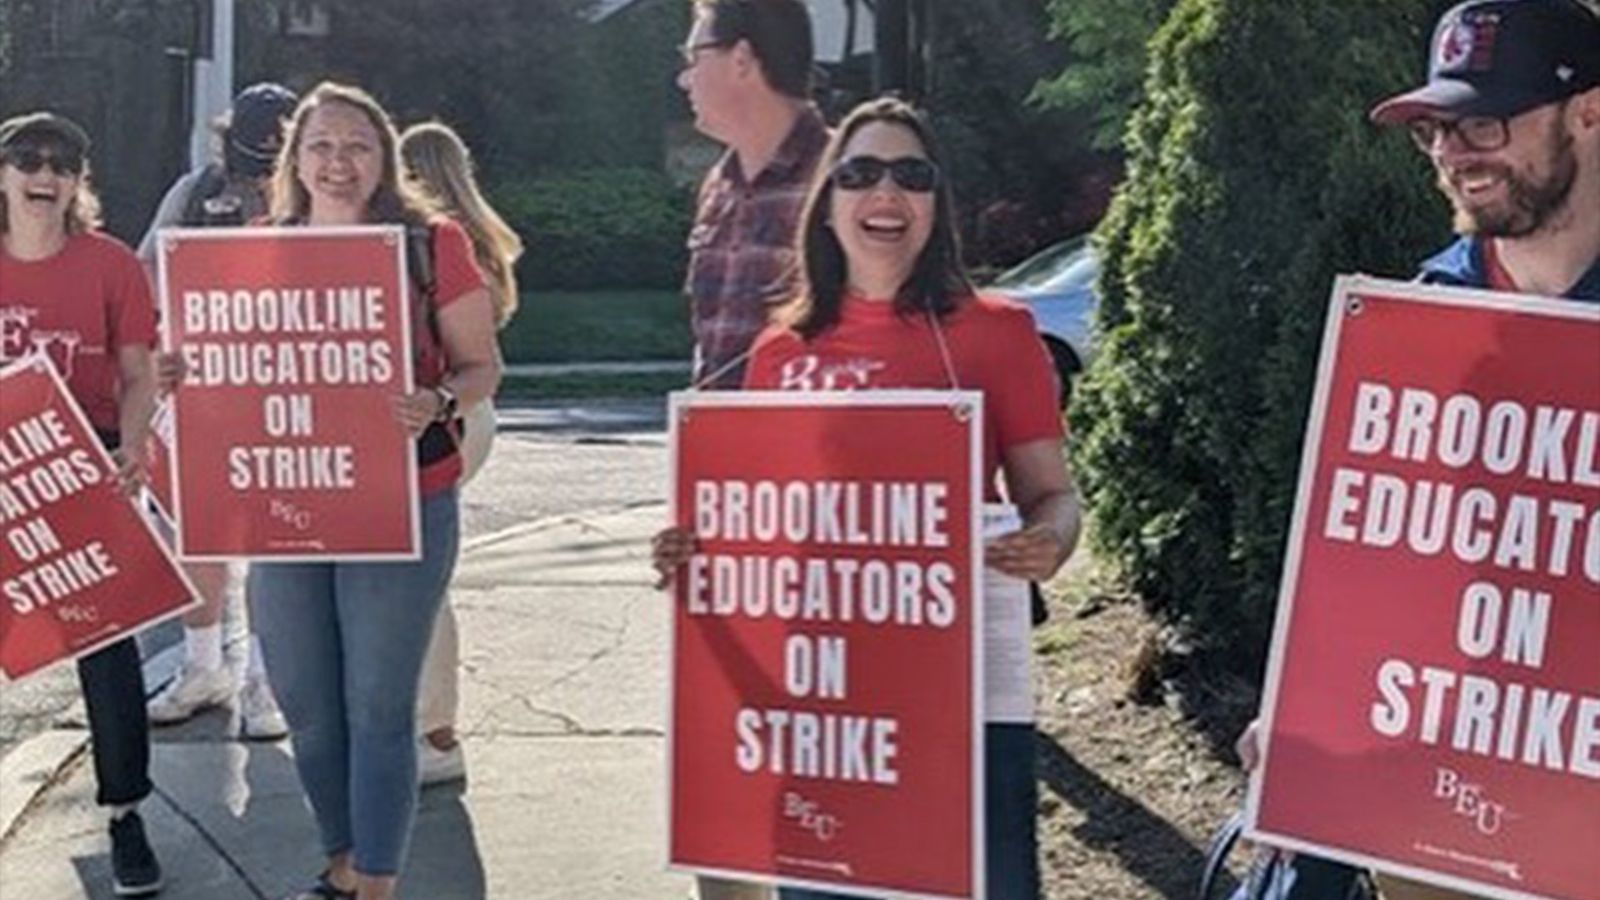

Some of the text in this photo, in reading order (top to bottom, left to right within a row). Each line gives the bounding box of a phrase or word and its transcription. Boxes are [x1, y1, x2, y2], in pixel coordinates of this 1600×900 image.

[183, 287, 386, 334] BROOKLINE
[181, 340, 393, 387] EDUCATORS
[0, 409, 73, 471] LINE
[264, 395, 313, 437] ON
[0, 449, 101, 524] ATORS
[228, 446, 355, 490] STRIKE
[7, 517, 61, 562] ON
[695, 480, 949, 548] BROOKLINE
[3, 541, 118, 615] STRIKE
[688, 556, 955, 628] EDUCATORS
[1457, 582, 1551, 668] ON
[785, 635, 847, 700] ON
[735, 710, 898, 785] STRIKE
[1371, 659, 1600, 779] STRIKE
[1434, 768, 1504, 834] BEU
